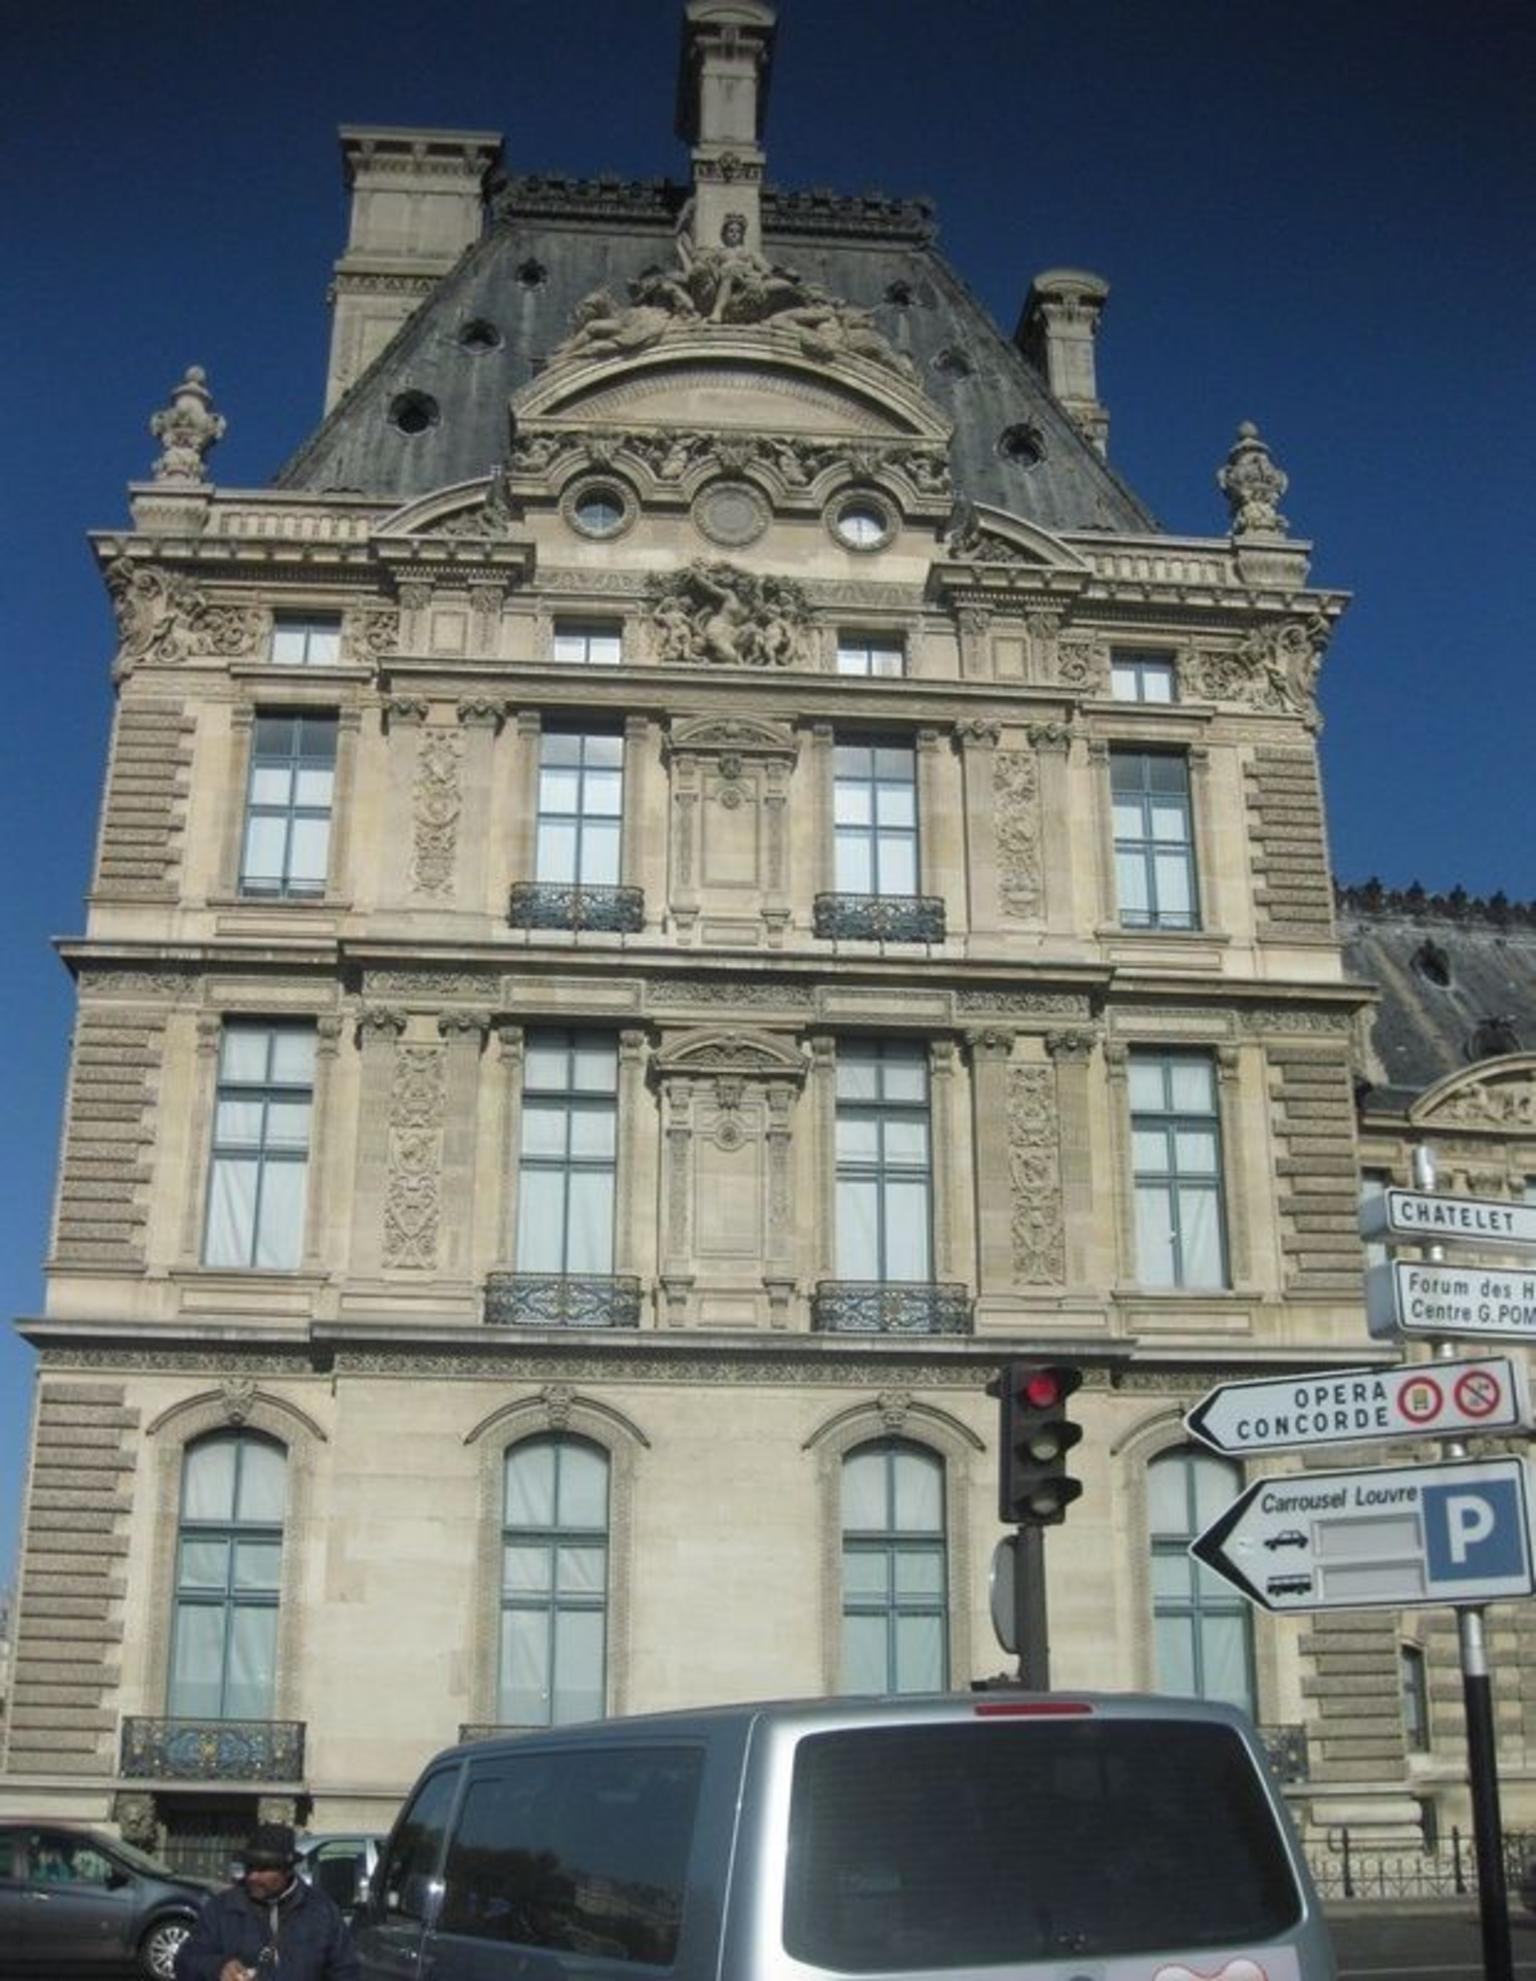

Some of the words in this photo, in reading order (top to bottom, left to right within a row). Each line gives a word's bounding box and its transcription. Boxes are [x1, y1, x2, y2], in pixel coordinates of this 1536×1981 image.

[1401, 1201, 1513, 1231] CHATELET
[1409, 1272, 1469, 1296] Forum
[1480, 1277, 1512, 1299] des
[1411, 1299, 1471, 1321] Centre
[1295, 1380, 1387, 1408] OPERA
[1237, 1407, 1389, 1440] CONCORDE
[1262, 1488, 1346, 1514] Carrousel
[1356, 1485, 1417, 1507] Louvre
[1446, 1496, 1495, 1563] P
